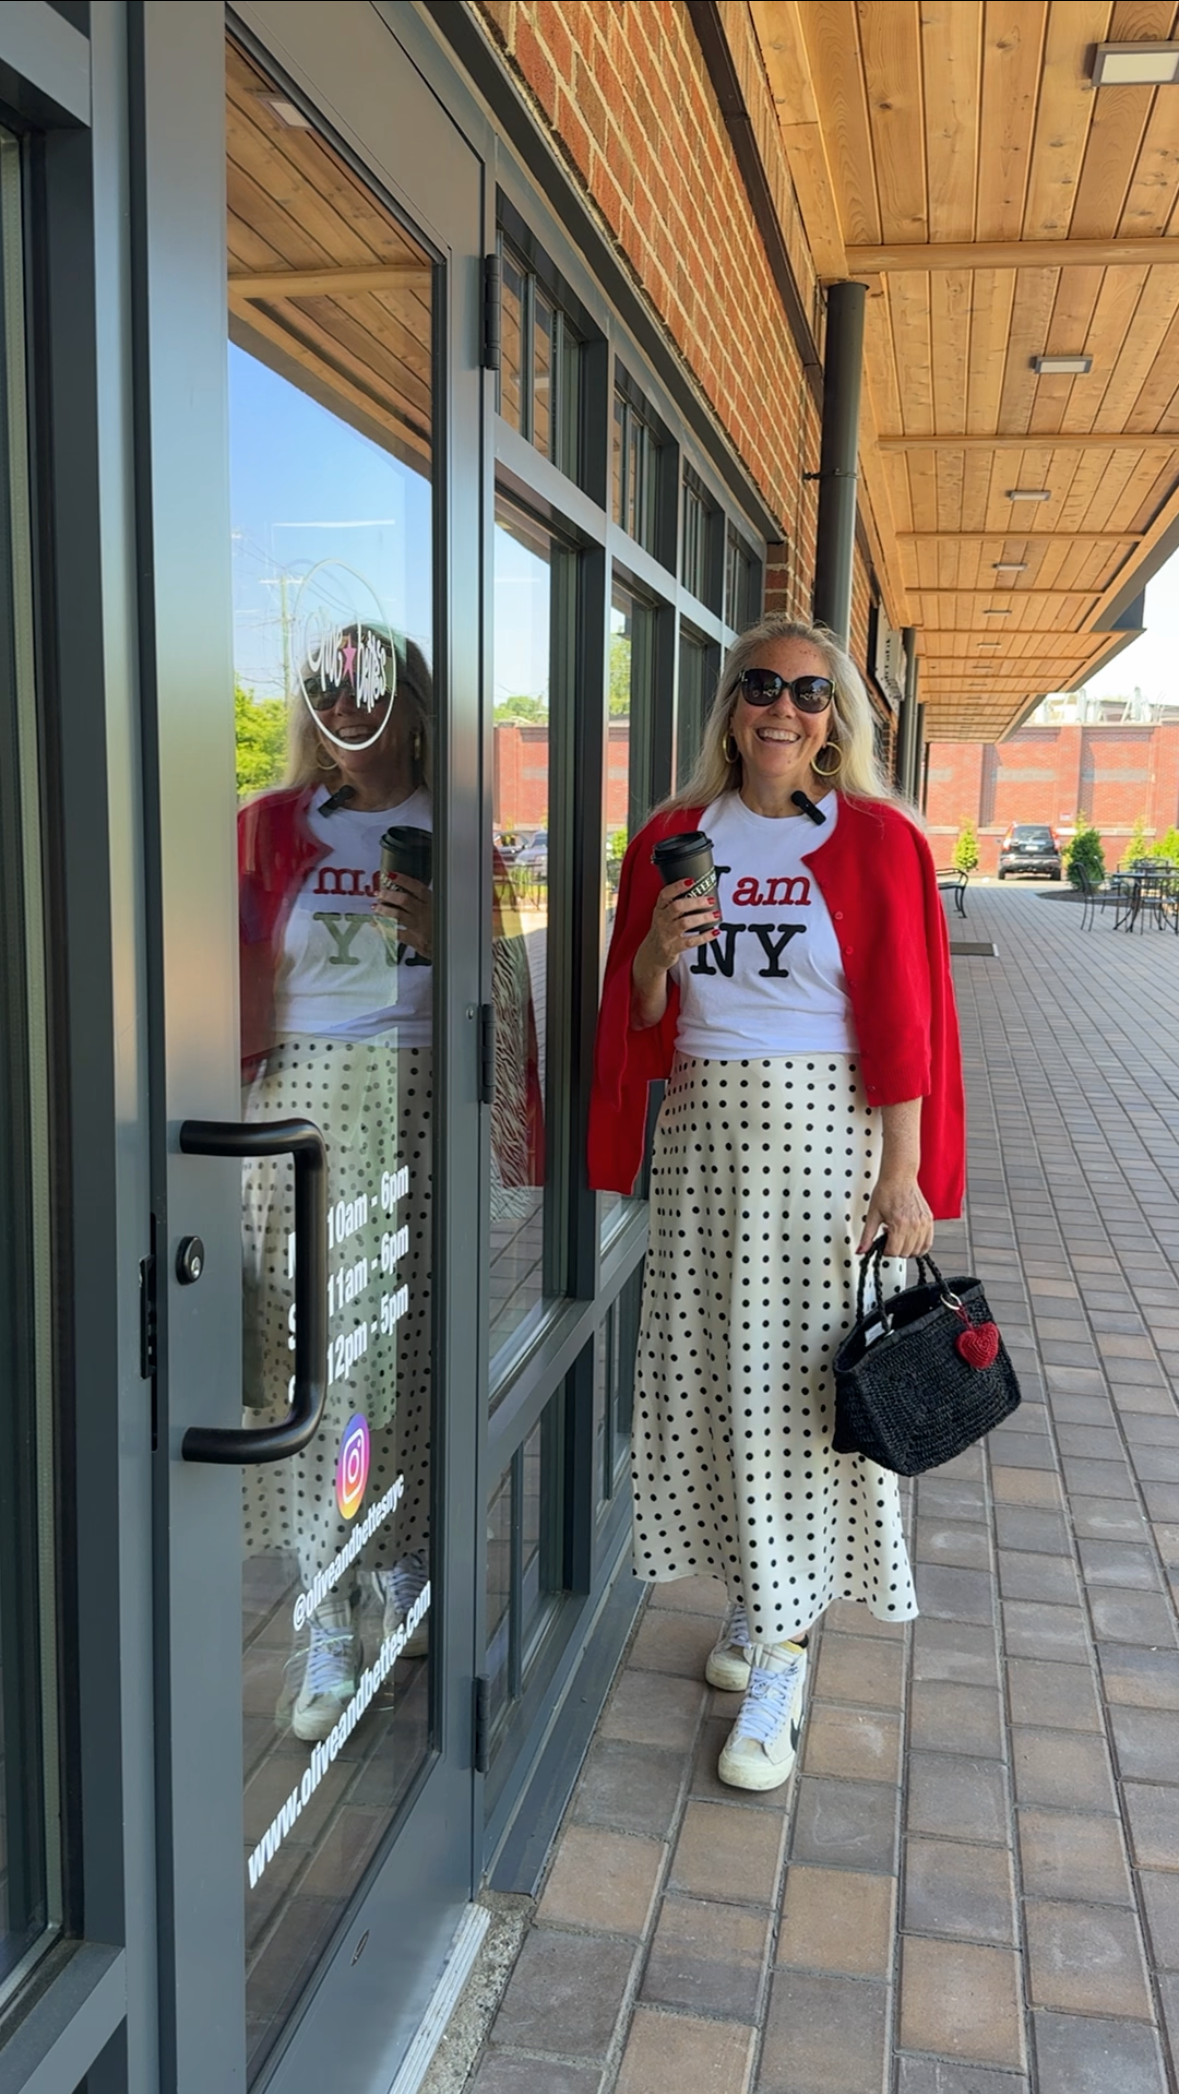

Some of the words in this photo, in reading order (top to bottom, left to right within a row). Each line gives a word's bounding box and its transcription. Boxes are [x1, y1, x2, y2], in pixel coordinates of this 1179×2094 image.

[731, 876, 812, 906] am
[690, 922, 807, 978] NY
[327, 1193, 368, 1250] 10am
[380, 1165, 409, 1214] 6pm
[327, 1257, 368, 1318] 11am
[380, 1225, 409, 1275] 6pm
[327, 1321, 368, 1386] 12pm
[380, 1284, 409, 1336] 5pm
[293, 1473, 405, 1632] @oliveandbettesnyc
[247, 1580, 431, 1890] www.oliveandbettes.com
